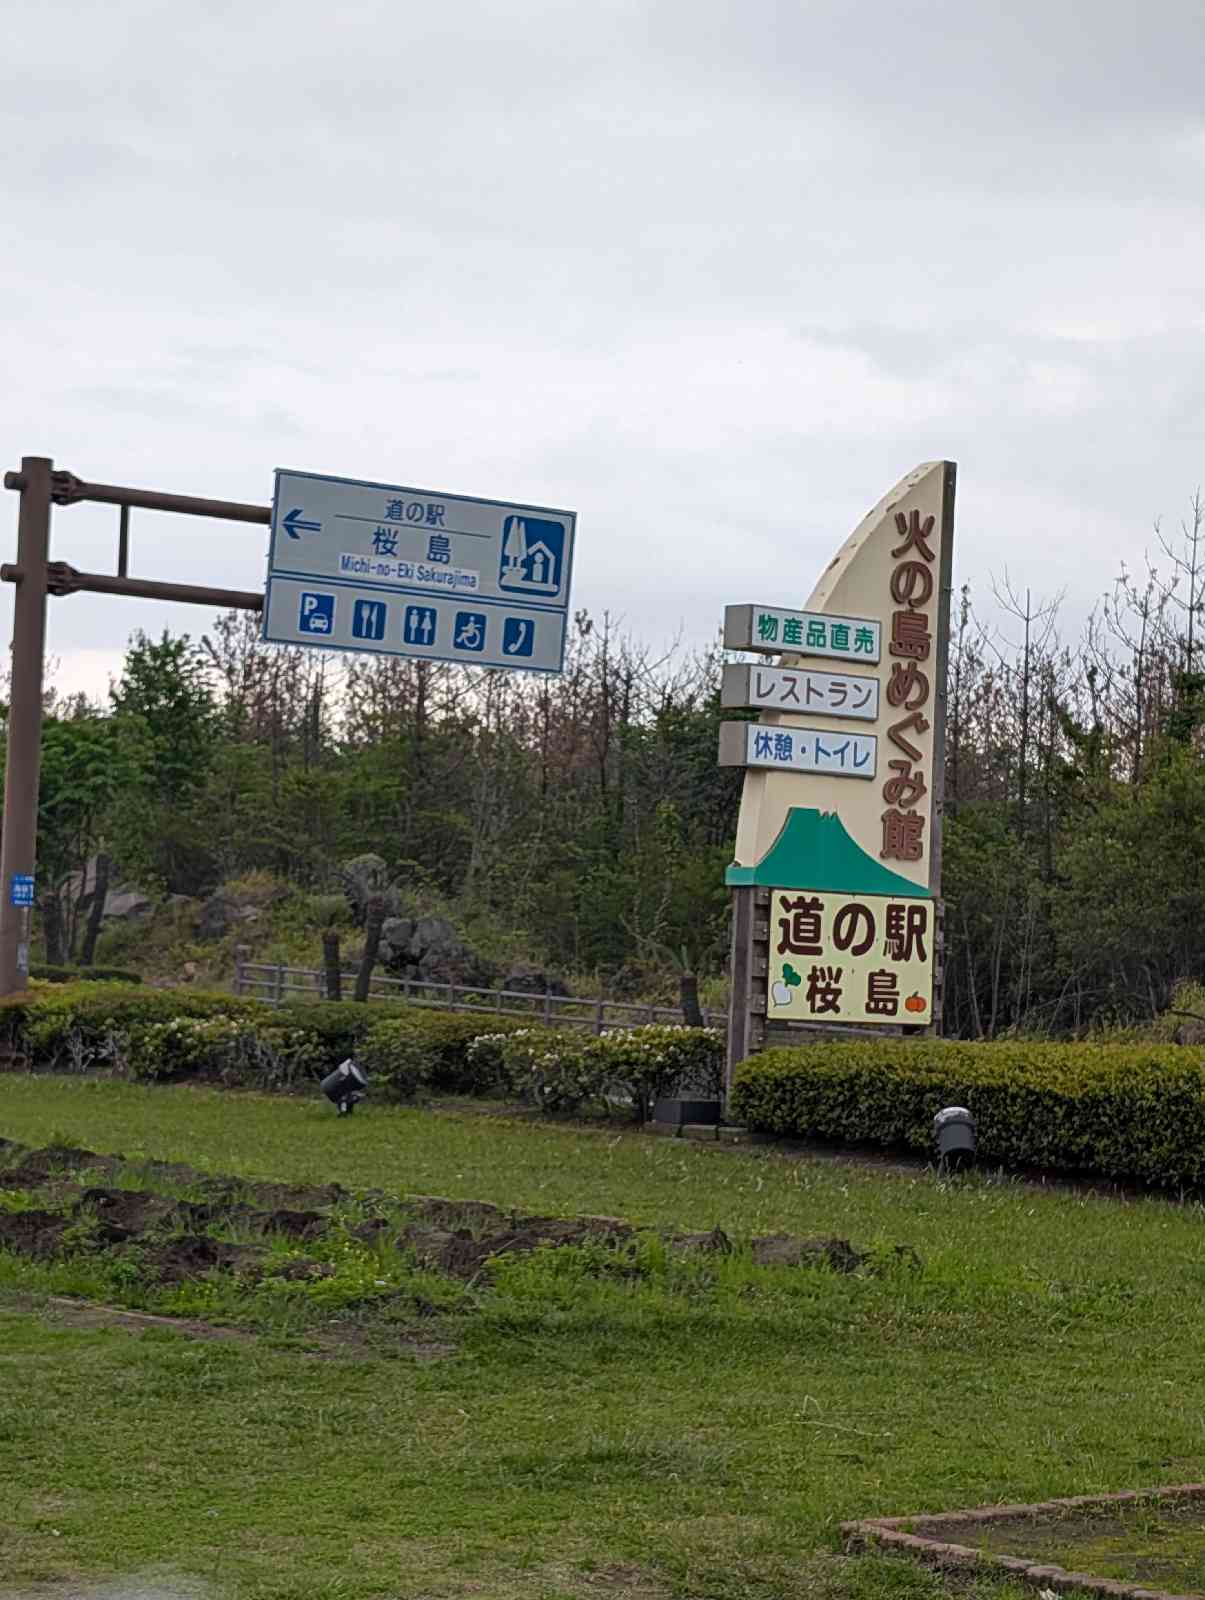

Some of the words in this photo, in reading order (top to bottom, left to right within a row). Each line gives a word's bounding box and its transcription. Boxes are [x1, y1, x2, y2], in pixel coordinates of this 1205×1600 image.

[385, 499, 445, 526] 道の駅
[372, 526, 452, 564] 桜島
[341, 555, 414, 579] Michi-no-Eki
[416, 565, 477, 588] Sakurajima
[757, 613, 875, 654] 物産品直売
[756, 672, 872, 709] レストラン
[880, 509, 935, 861] 火の島めぐみ館
[754, 731, 871, 768] 休憩・トイレ
[777, 895, 927, 962] 道の駅
[806, 965, 900, 1016] 桜島
